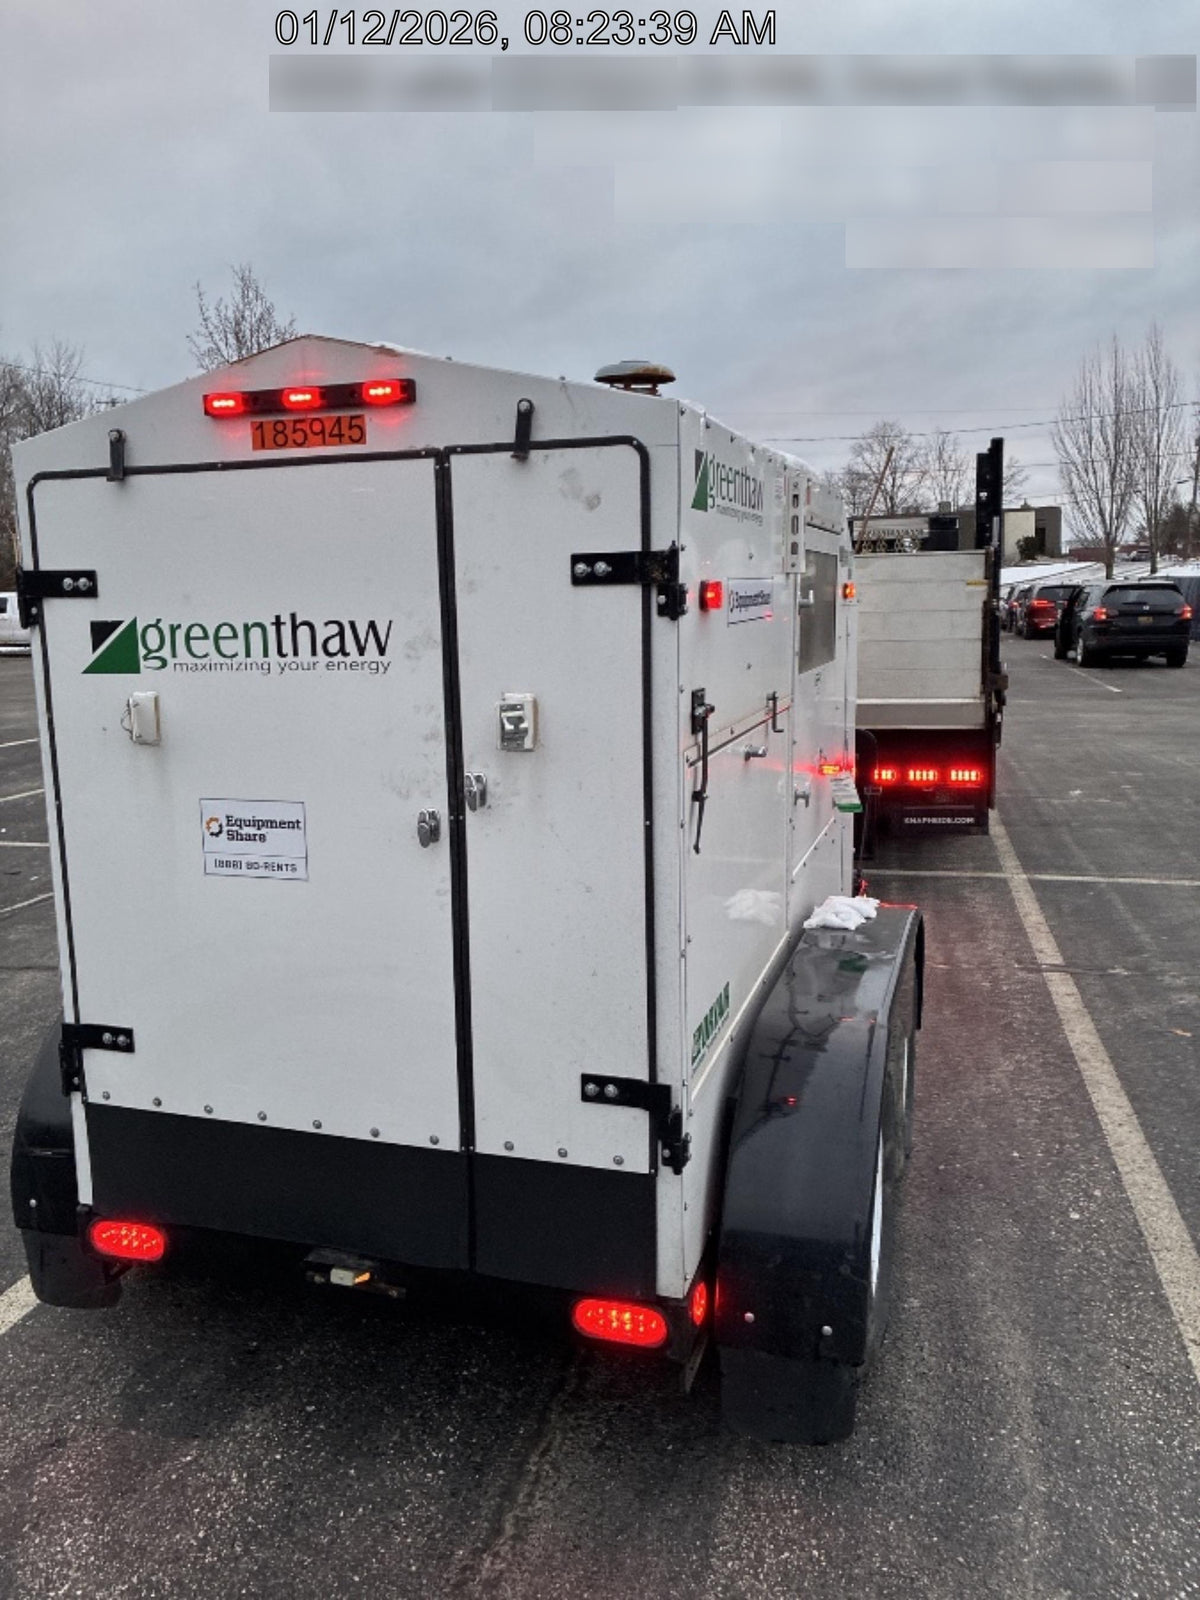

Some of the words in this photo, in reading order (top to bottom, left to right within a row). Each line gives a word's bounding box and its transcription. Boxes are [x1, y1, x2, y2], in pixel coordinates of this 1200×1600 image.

[255, 415, 364, 448] 185945
[707, 453, 765, 512] greenthaw
[140, 612, 393, 670] greenthaw
[173, 658, 271, 676] maximizing
[277, 660, 319, 676] your
[325, 658, 392, 675] energy
[225, 814, 302, 831] Equipment
[226, 829, 267, 843] Share
